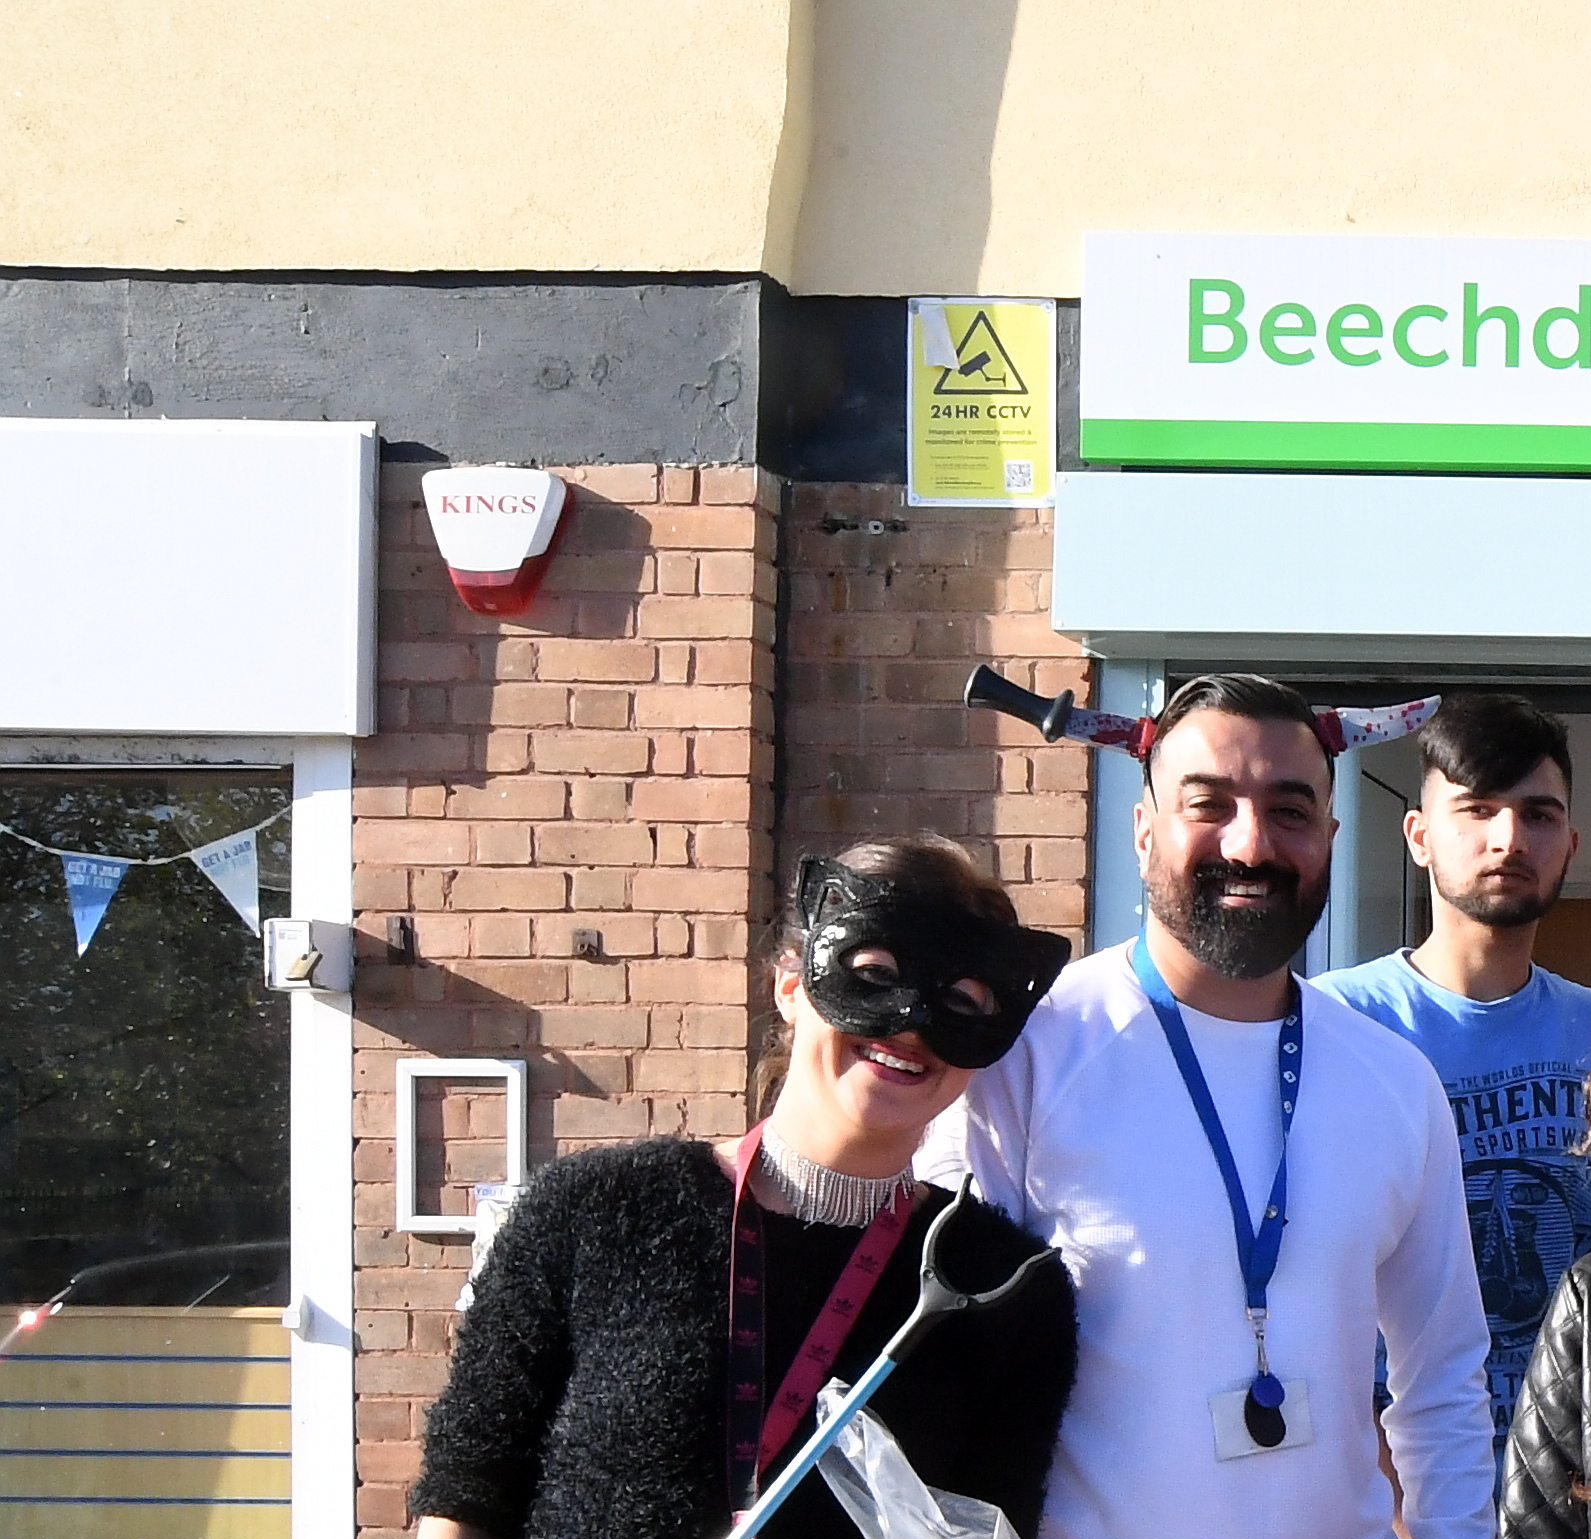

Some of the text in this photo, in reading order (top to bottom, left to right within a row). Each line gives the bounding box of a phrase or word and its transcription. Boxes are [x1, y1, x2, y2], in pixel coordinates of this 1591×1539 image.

[986, 405, 1032, 419] CCTV
[441, 495, 537, 514] KINGS
[1461, 1061, 1572, 1089] THE WORLDS OFFICIAL
[1448, 1079, 1585, 1136] THENT
